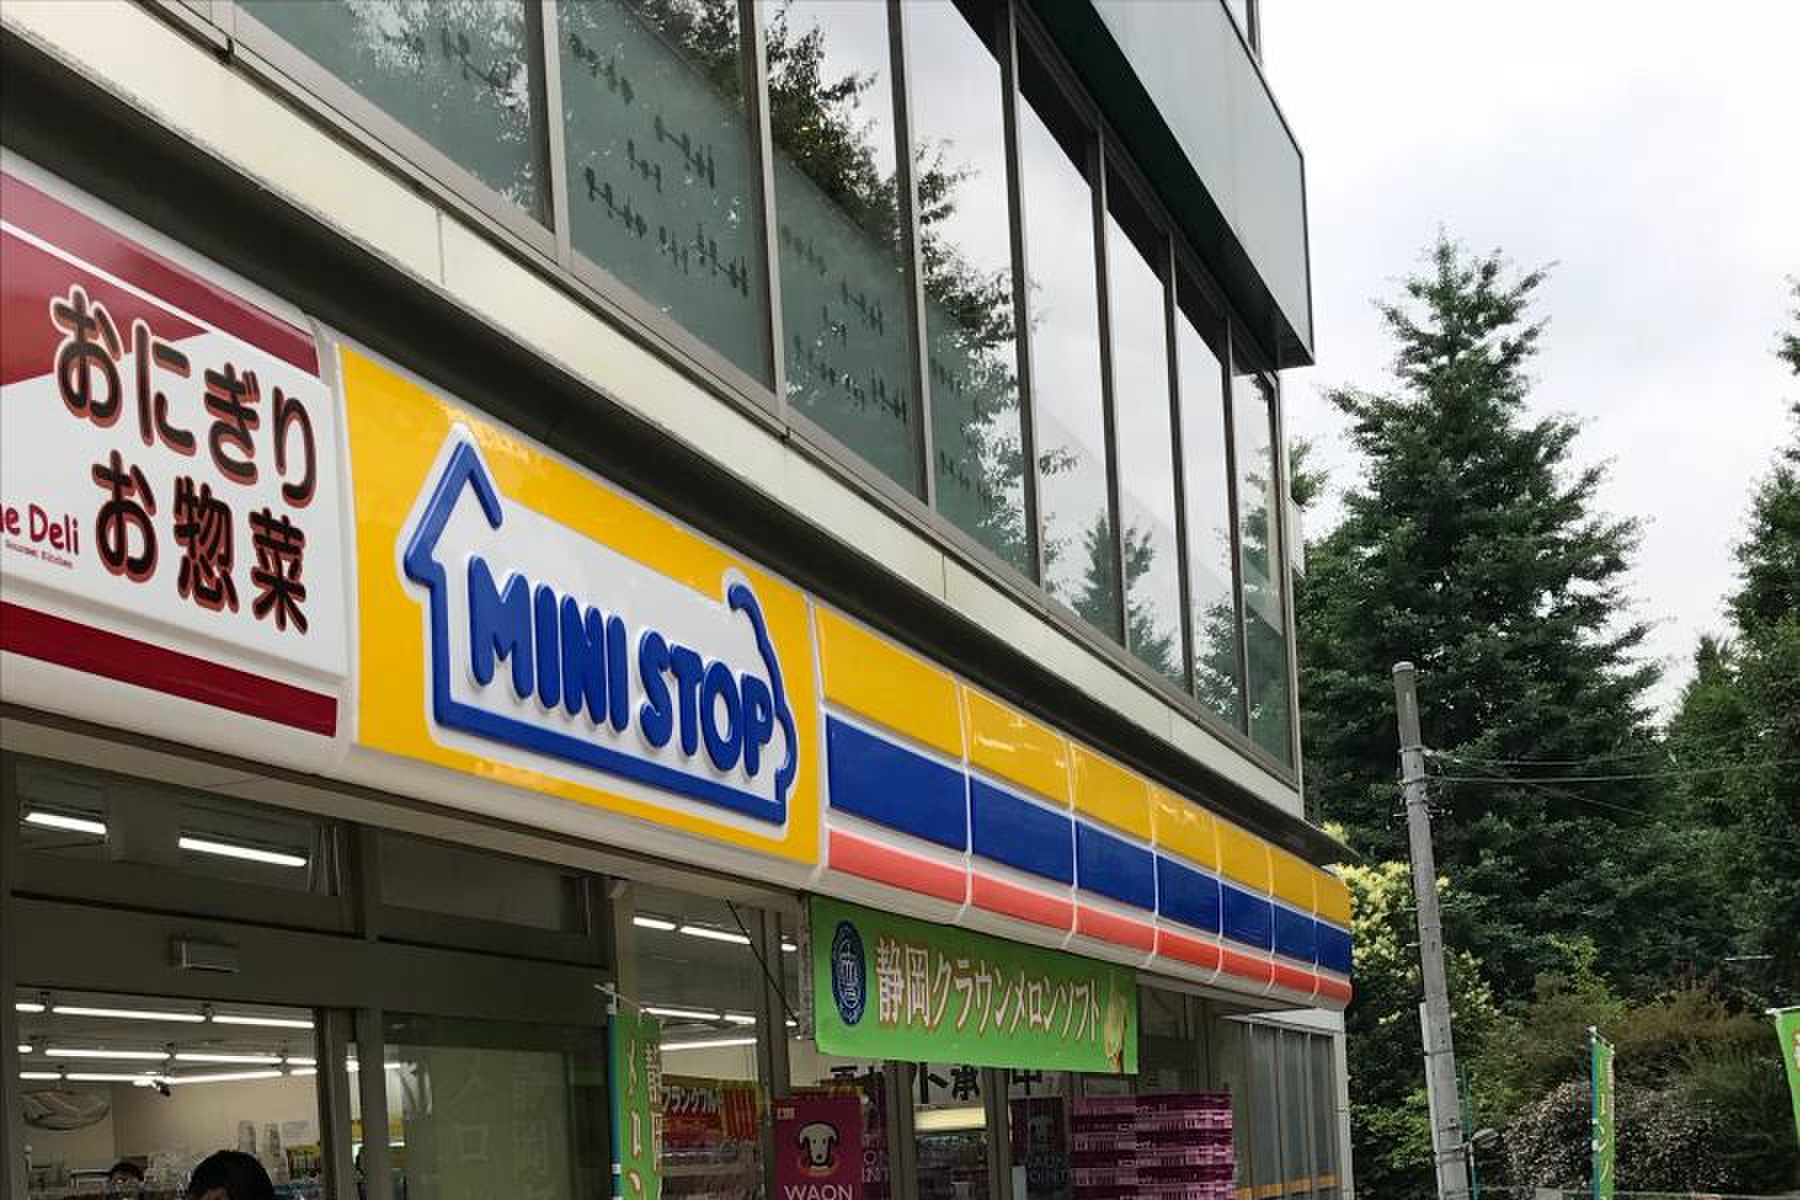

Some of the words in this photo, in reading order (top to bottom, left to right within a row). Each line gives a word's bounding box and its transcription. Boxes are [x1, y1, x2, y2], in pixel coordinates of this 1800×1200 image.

[51, 286, 317, 508] おにぎり
[29, 503, 79, 555] Deli
[92, 449, 310, 637] お惣菜
[467, 555, 628, 733] MINI
[637, 630, 777, 778] STOP
[876, 936, 1100, 1042] 静岡クラウンメロンソフト
